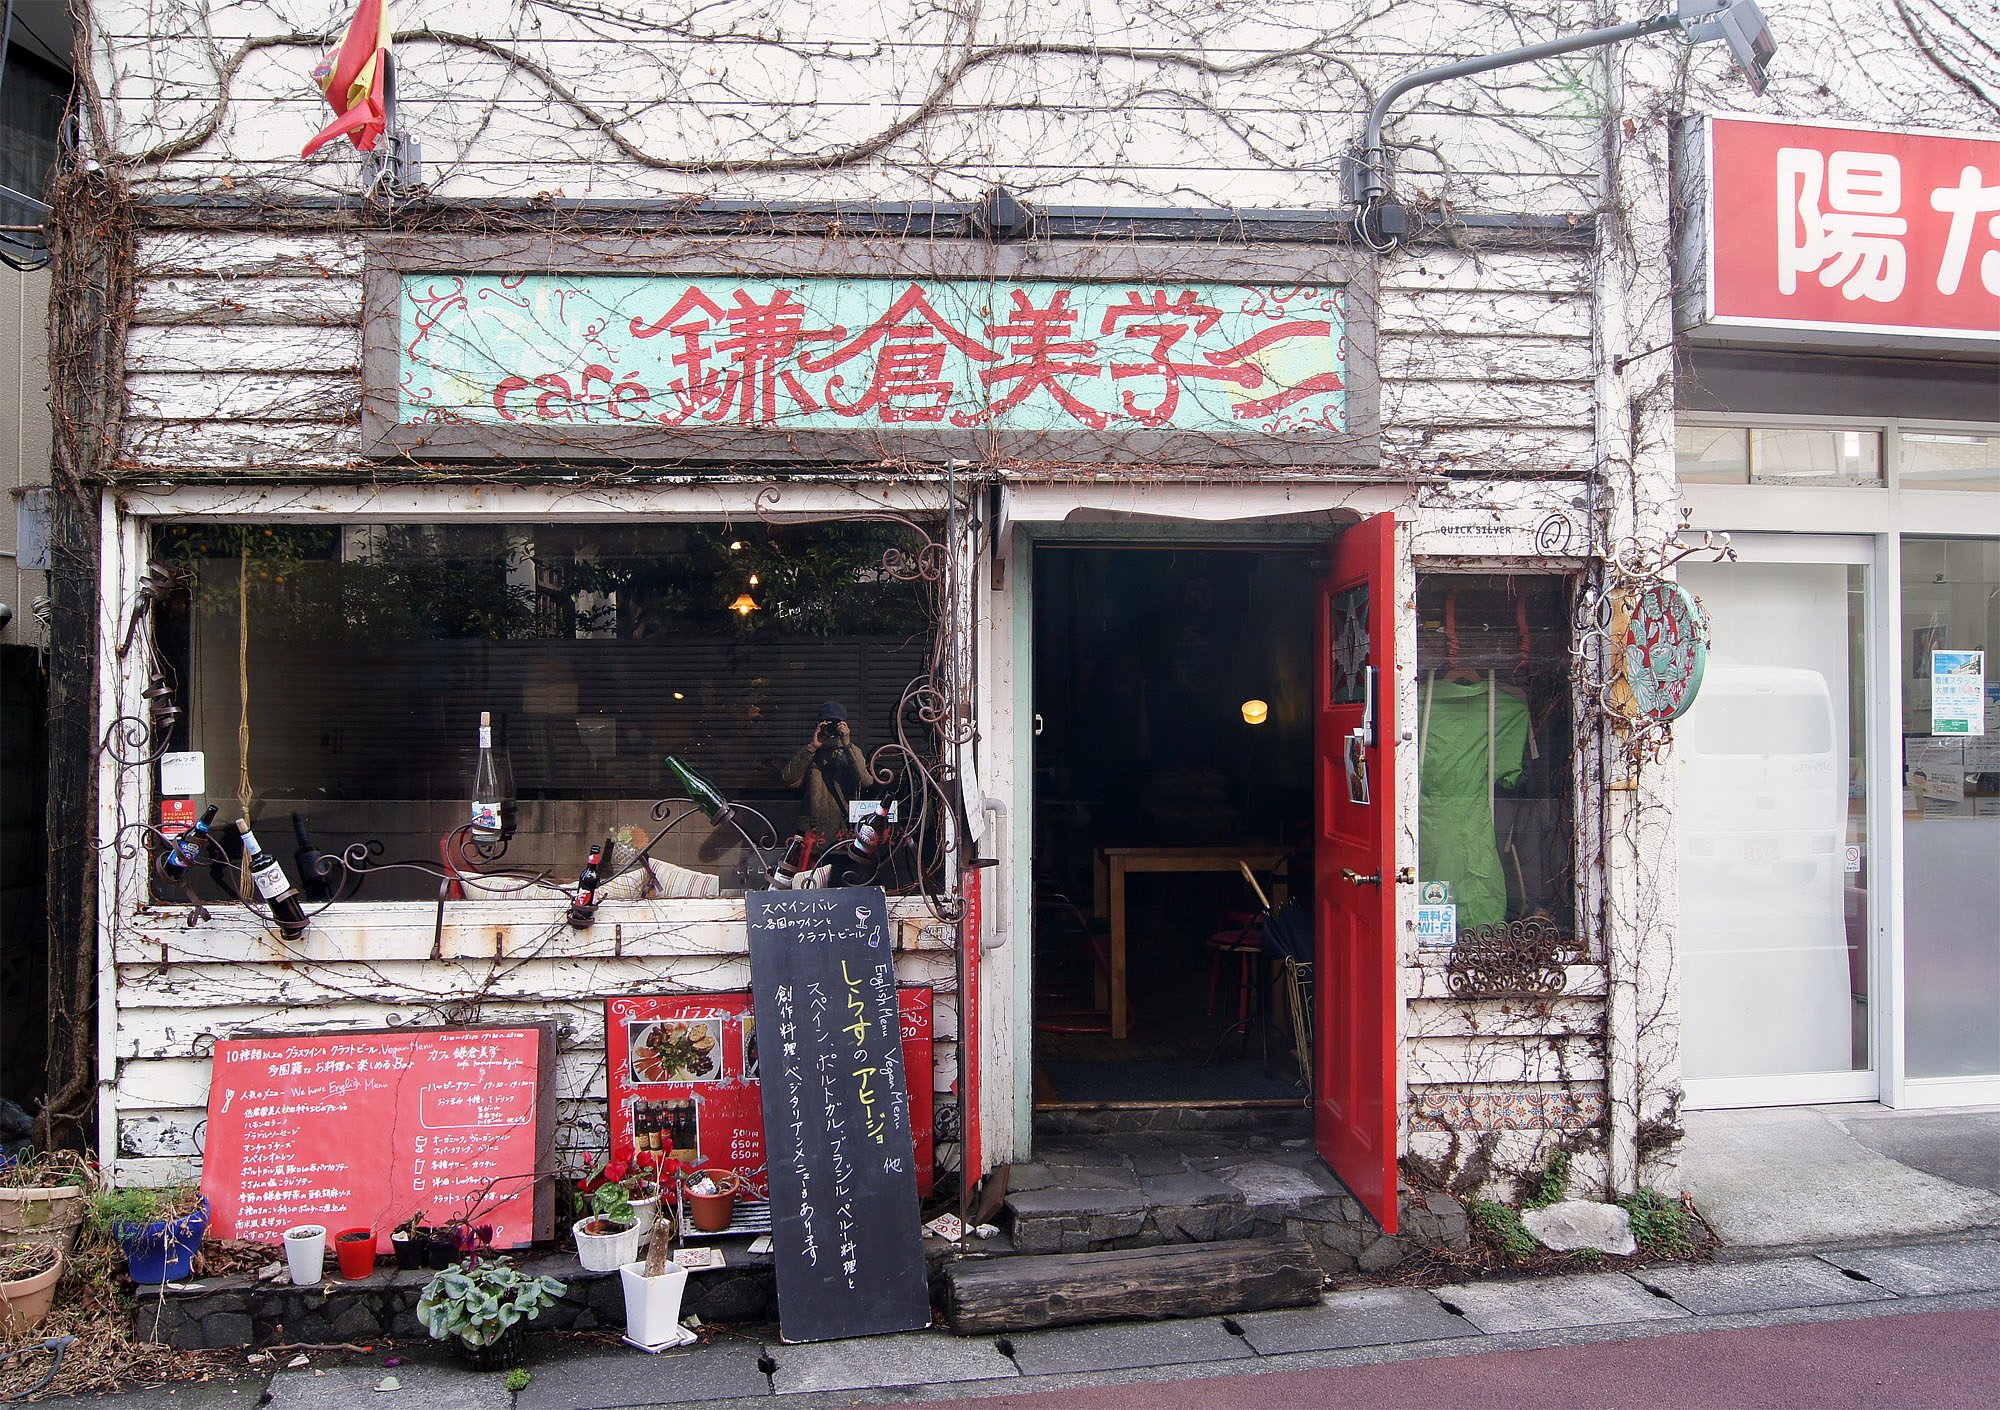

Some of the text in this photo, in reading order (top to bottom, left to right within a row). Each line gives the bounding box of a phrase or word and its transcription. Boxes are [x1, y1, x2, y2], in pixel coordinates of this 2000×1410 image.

[630, 282, 1263, 429] 鎌倉美学
[1441, 525, 1512, 535] QUICK SILVER
[762, 899, 839, 915] スペインバル
[1419, 910, 1441, 922] 無料
[1419, 922, 1452, 934] Wi-Fi
[797, 929, 865, 943] クラフトビール
[410, 1041, 434, 1052] Menu
[869, 964, 904, 1130] English Menu Vegan Menu
[291, 1088, 306, 1097] We
[308, 1086, 327, 1096] have
[328, 1077, 362, 1096] English
[364, 1078, 389, 1091] Menu
[884, 1158, 903, 1174] 他
